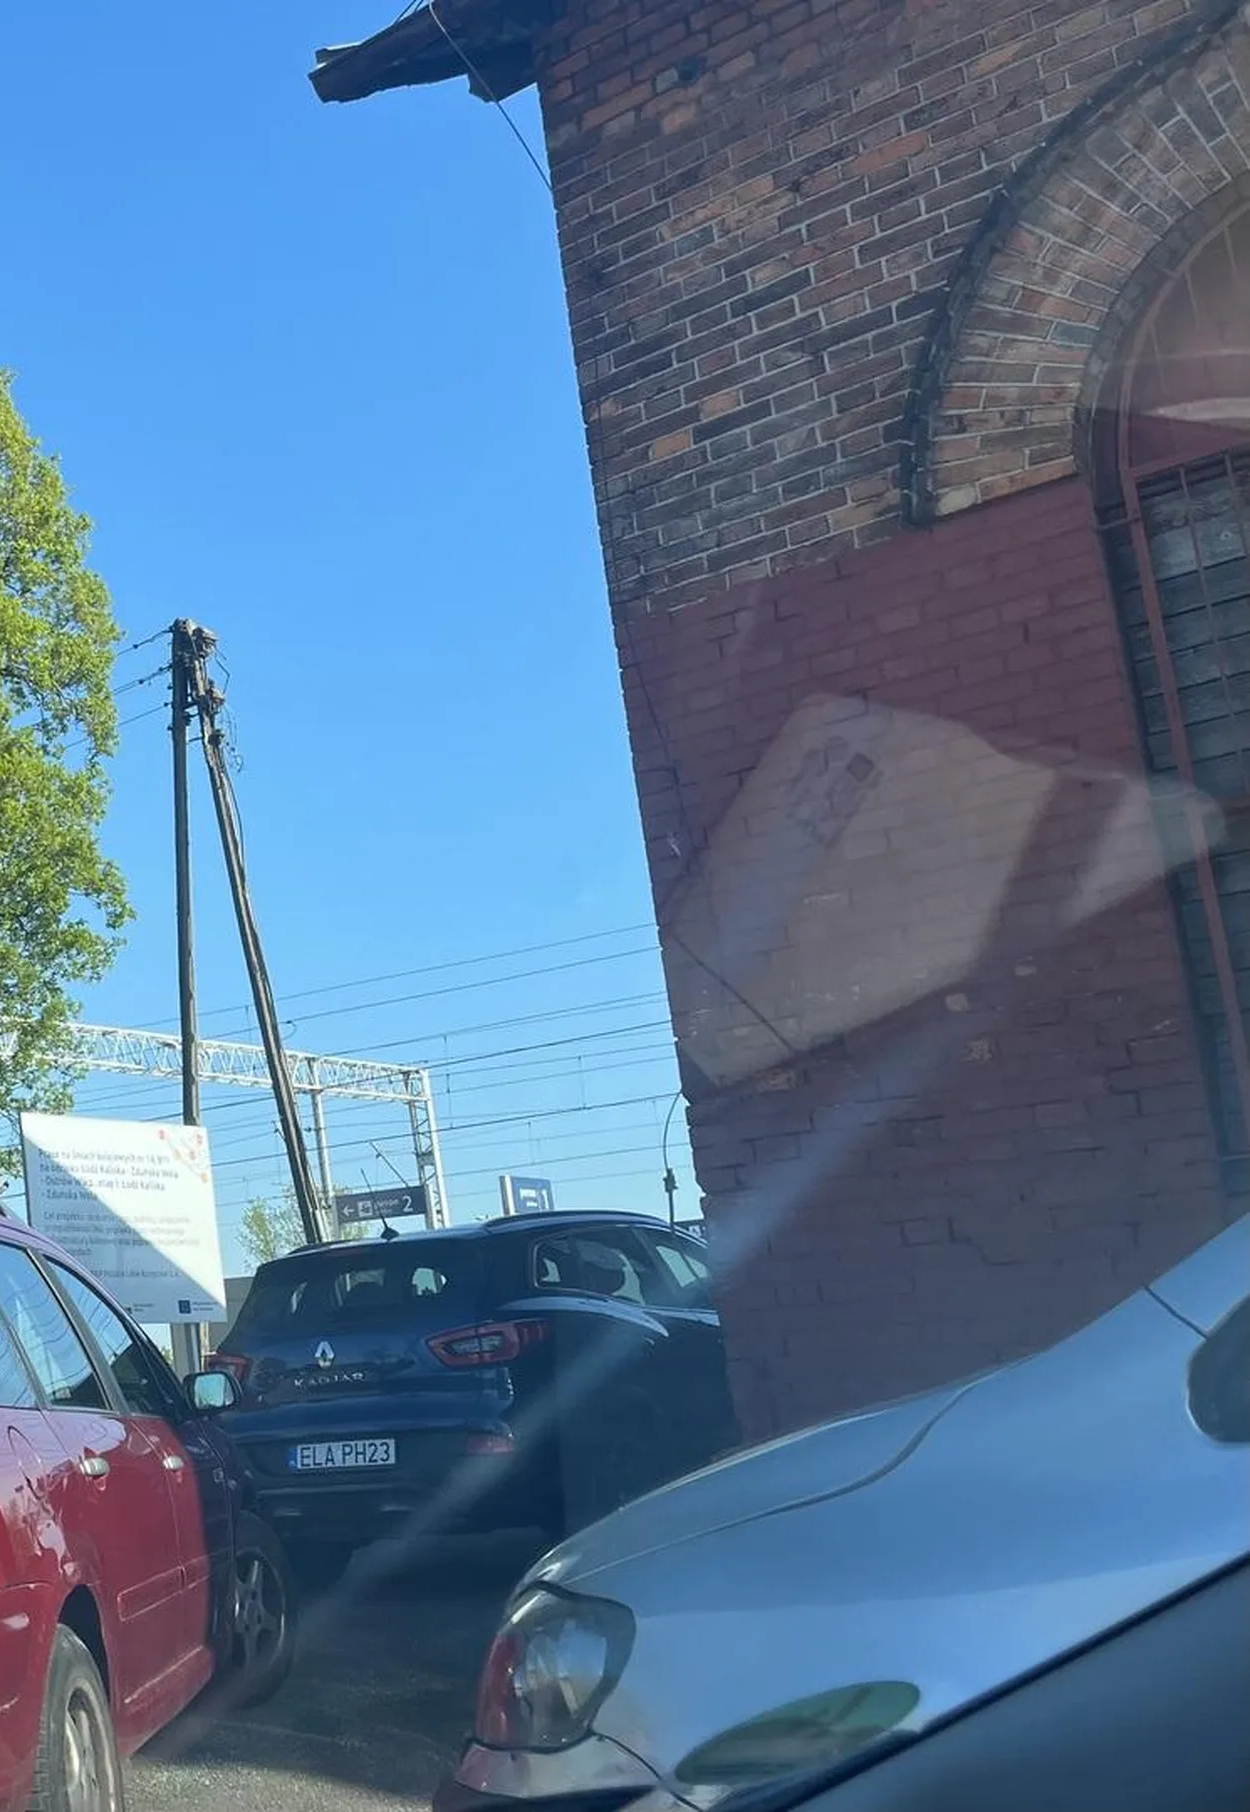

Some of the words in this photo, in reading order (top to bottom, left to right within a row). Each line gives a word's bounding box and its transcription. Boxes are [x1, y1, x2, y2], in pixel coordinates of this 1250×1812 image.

[401, 1195, 414, 1213] 2
[300, 1445, 336, 1468] ELA
[341, 1441, 391, 1465] PH23
